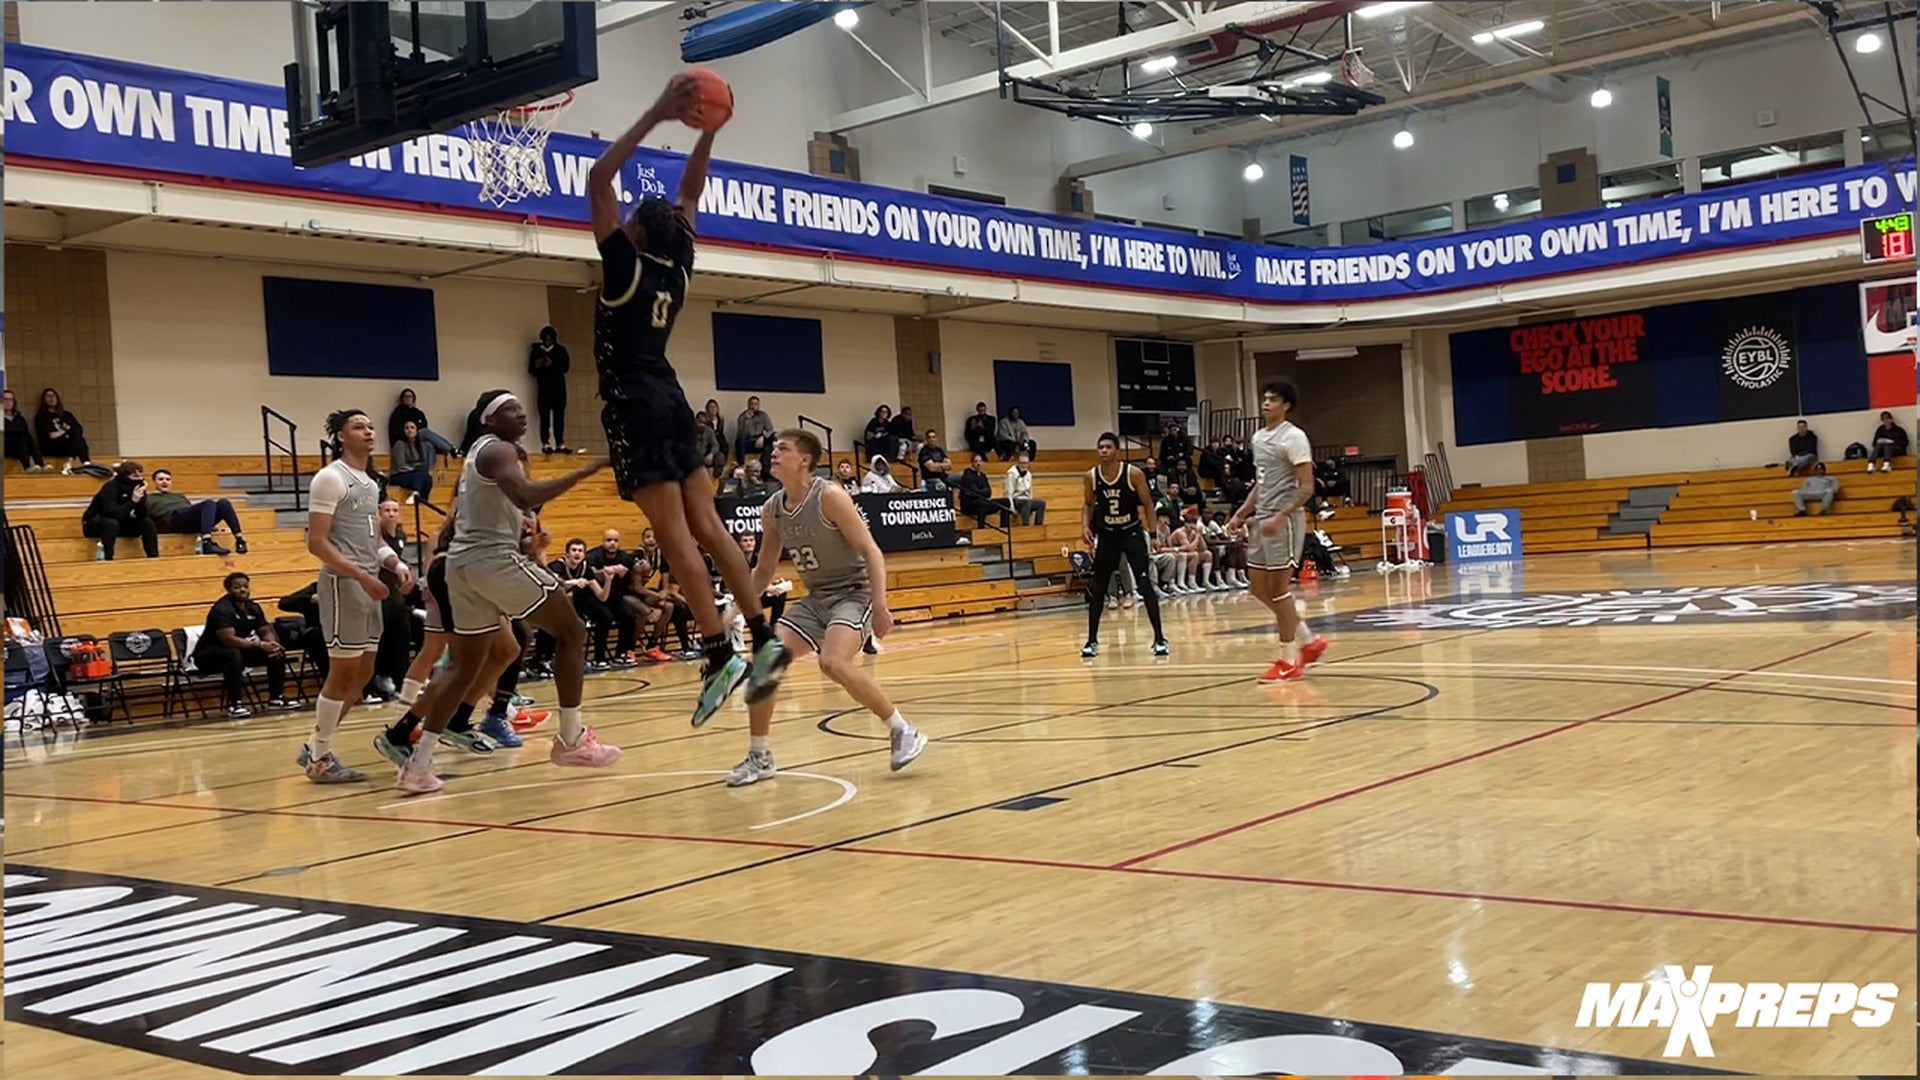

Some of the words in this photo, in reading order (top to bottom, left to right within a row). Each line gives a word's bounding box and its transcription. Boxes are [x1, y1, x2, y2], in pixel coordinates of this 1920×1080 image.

[49, 75, 175, 142] OWN
[185, 95, 292, 158] TIME
[637, 163, 656, 180] Just
[640, 179, 656, 192] Do
[698, 176, 777, 222] MAKE
[783, 188, 880, 236] FRIENDS
[885, 204, 919, 241] ON
[922, 210, 983, 250] YOUR
[987, 219, 1035, 257] OWN
[1037, 226, 1088, 270] TIME,
[1090, 235, 1122, 267] I'M
[1125, 239, 1165, 272] HERE
[1167, 245, 1188, 275] TO
[1189, 248, 1226, 279] WIN.
[1256, 256, 1306, 285] MAKE
[1310, 252, 1411, 285] FRIENDS
[1417, 246, 1455, 276] ON
[1461, 235, 1533, 270] YOUR
[1540, 221, 1608, 258] OWN
[1613, 209, 1692, 243] TIME,
[1699, 198, 1752, 234] I'M
[1760, 184, 1838, 225] HERE
[1845, 176, 1888, 211] TO
[652, 290, 672, 328] 0
[1510, 322, 1578, 352] CHECK
[1581, 314, 1646, 343] YOUR
[1520, 348, 1564, 374] EGO
[1567, 345, 1592, 368] AT
[1595, 338, 1638, 366] THE
[1739, 350, 1774, 364] EYBL
[1541, 365, 1618, 394] SCORE.
[1731, 369, 1784, 389] SCHOLASTIC
[880, 508, 957, 526] TOURNAMENT
[888, 498, 948, 511] CONFERENCE
[1109, 499, 1120, 515] 2
[367, 514, 375, 537] 1
[789, 545, 820, 572] 23
